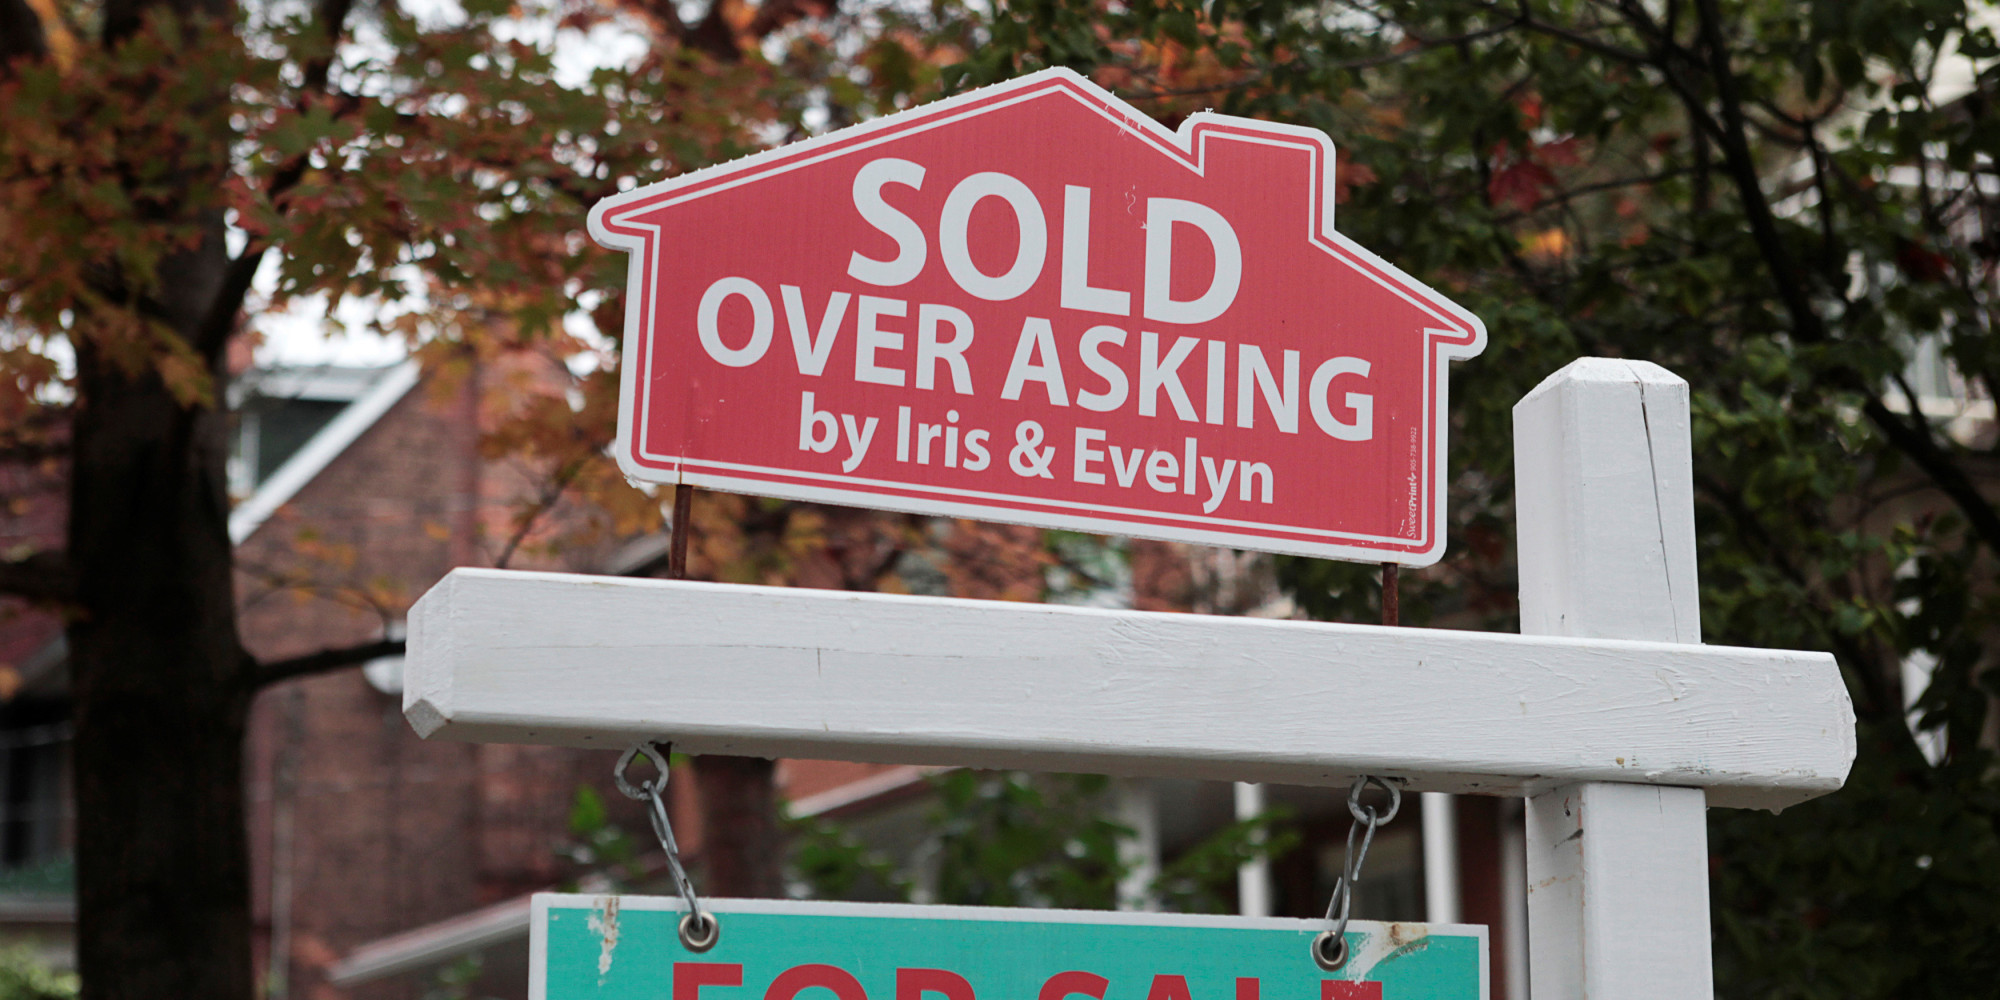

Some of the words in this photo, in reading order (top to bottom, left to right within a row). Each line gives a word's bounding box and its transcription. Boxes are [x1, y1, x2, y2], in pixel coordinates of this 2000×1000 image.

[846, 157, 1243, 325] SOLD
[697, 276, 975, 396] OVER
[1000, 316, 1374, 442] ASKING
[798, 390, 880, 474] by
[896, 405, 991, 472] Iris
[1008, 420, 1056, 480] &
[1073, 426, 1274, 514] Evelyn
[1407, 480, 1417, 539] SweetPrint
